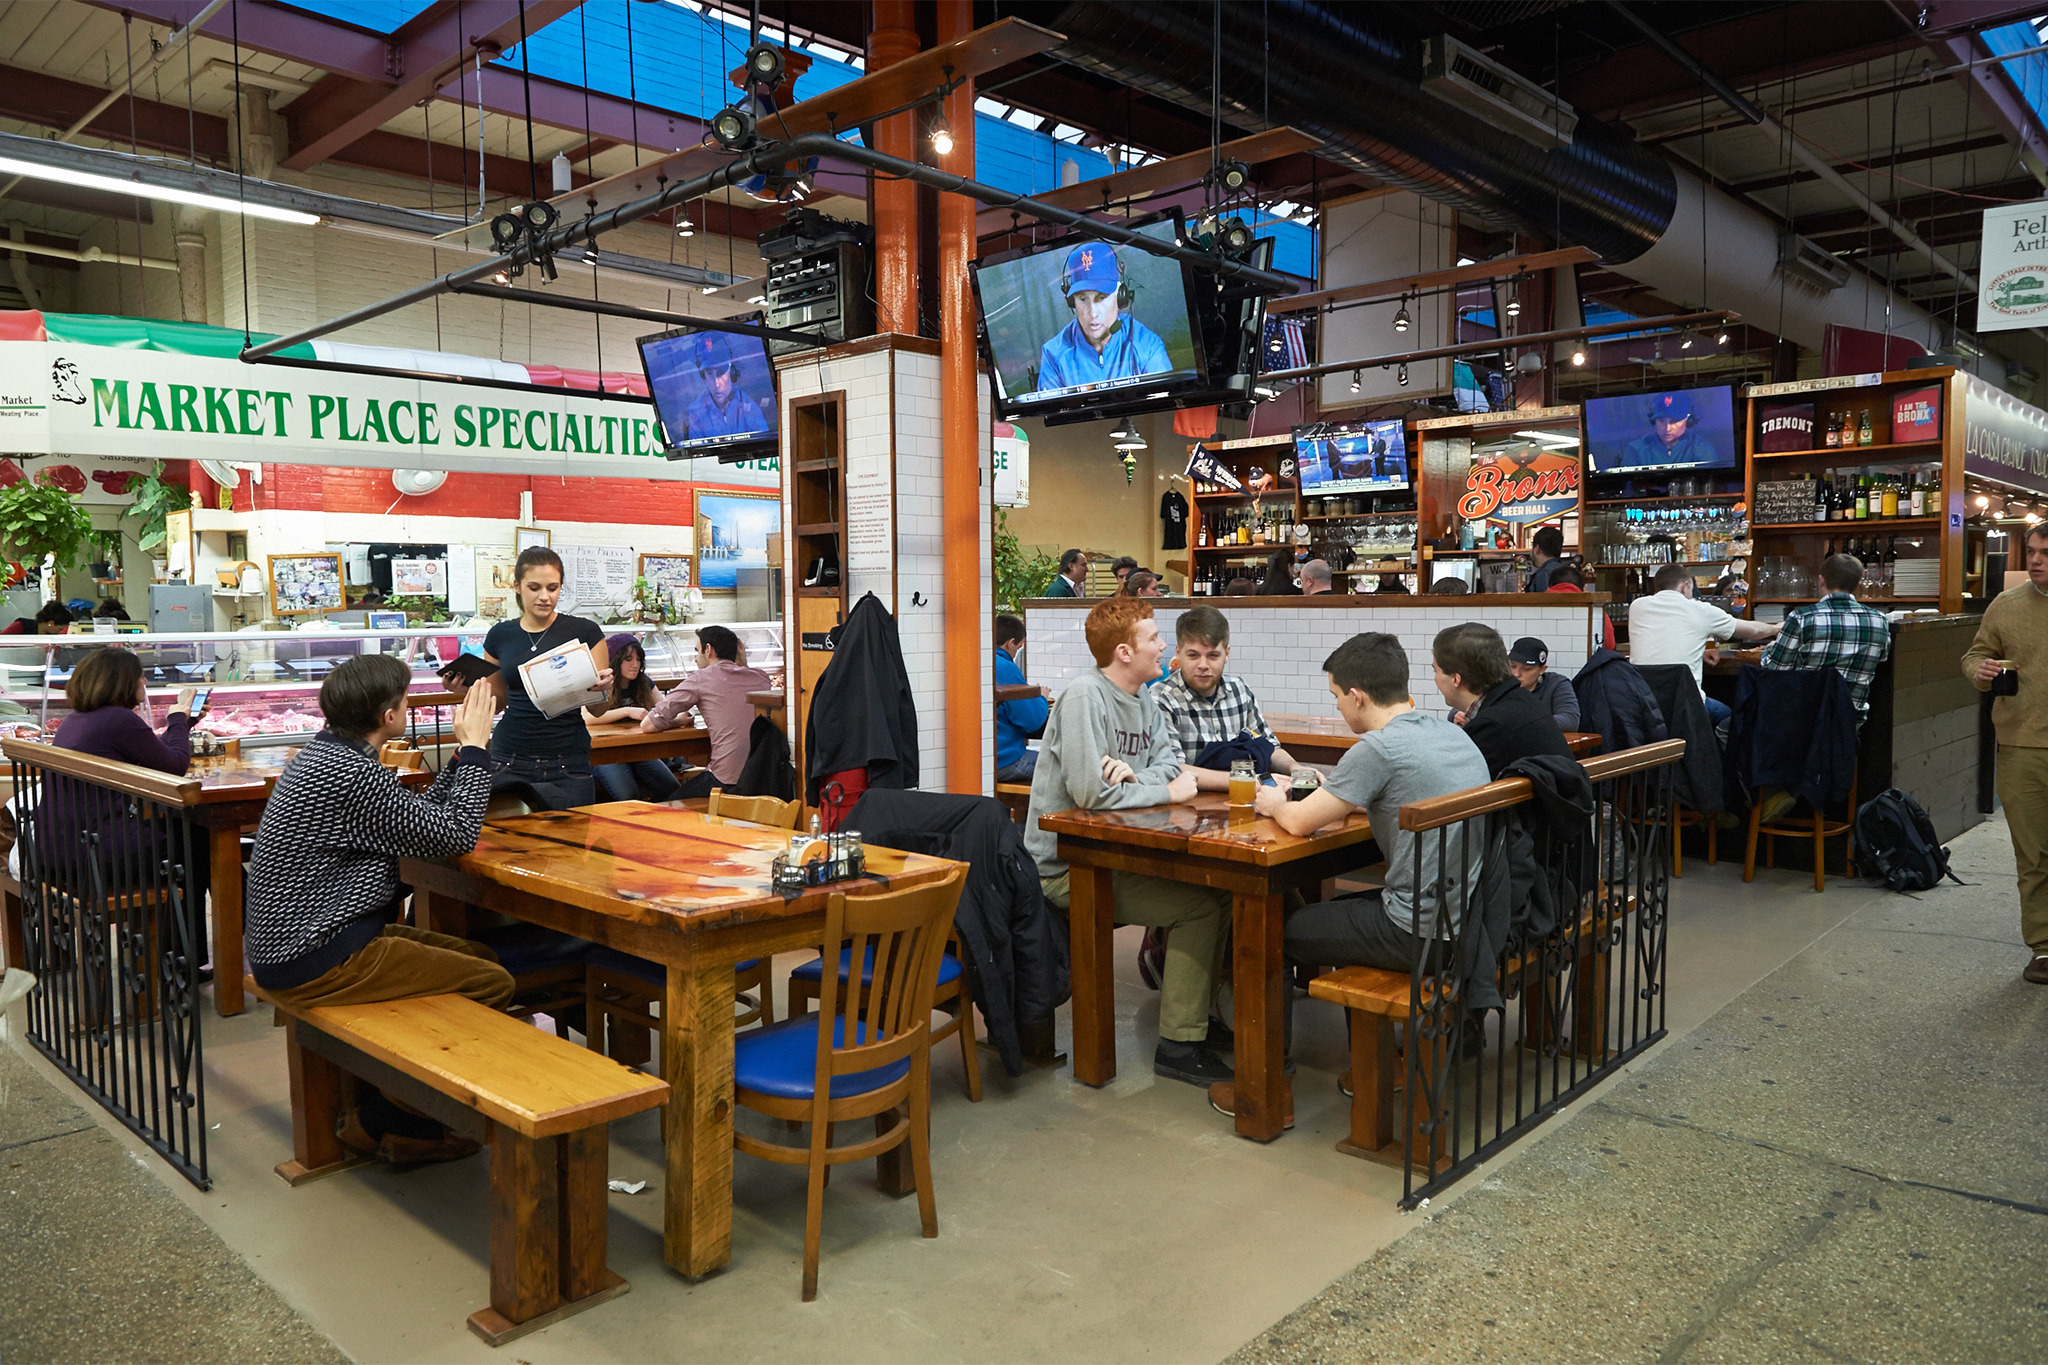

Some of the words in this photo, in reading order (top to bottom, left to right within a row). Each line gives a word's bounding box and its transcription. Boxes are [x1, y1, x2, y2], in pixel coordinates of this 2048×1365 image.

[1, 395, 33, 405] Market
[1904, 402, 1914, 411] AM
[1915, 401, 1928, 410] THE
[90, 377, 294, 438] MARKET
[308, 394, 442, 446] PLACE
[454, 404, 665, 458] SPECIALTIES
[1897, 408, 1930, 424] BRONX
[1761, 416, 1814, 434] TREMONT
[1966, 421, 1978, 456] LA
[1979, 427, 2001, 463] CASA
[1482, 456, 1495, 466] The
[1457, 464, 1580, 520] Bronx
[1501, 506, 1523, 517] BEER
[1525, 504, 1548, 515] HALL
[1780, 513, 1799, 523] Gold
